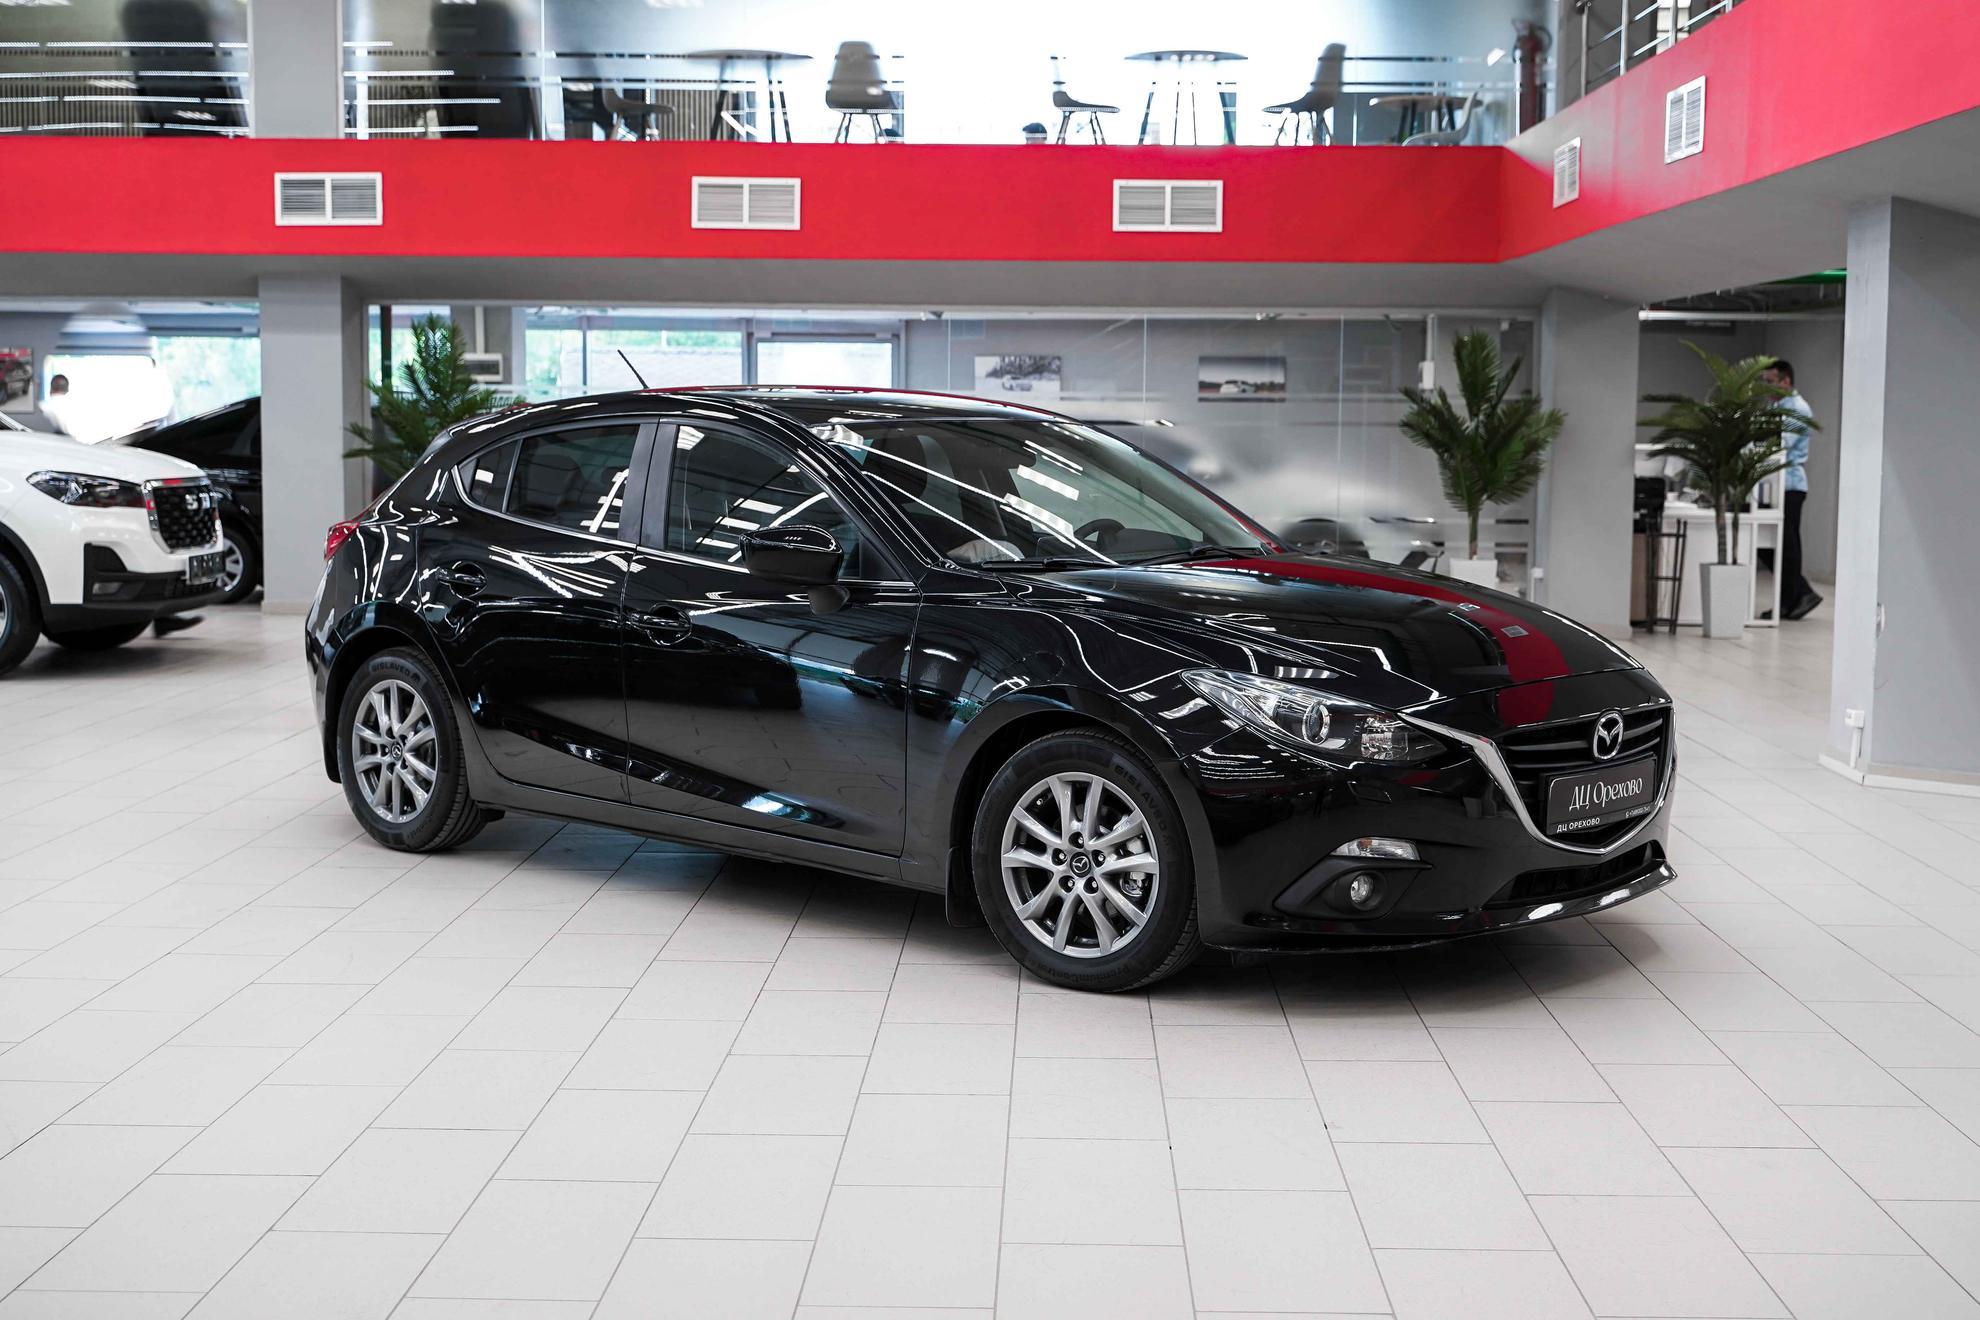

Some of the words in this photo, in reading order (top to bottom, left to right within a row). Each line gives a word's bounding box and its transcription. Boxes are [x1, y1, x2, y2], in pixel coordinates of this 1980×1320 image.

[1569, 784, 1591, 812] ДЦ
[1593, 777, 1643, 807] Орехово
[1556, 824, 1568, 834] ДЦ
[1569, 817, 1601, 830] ОРЕХОВО
